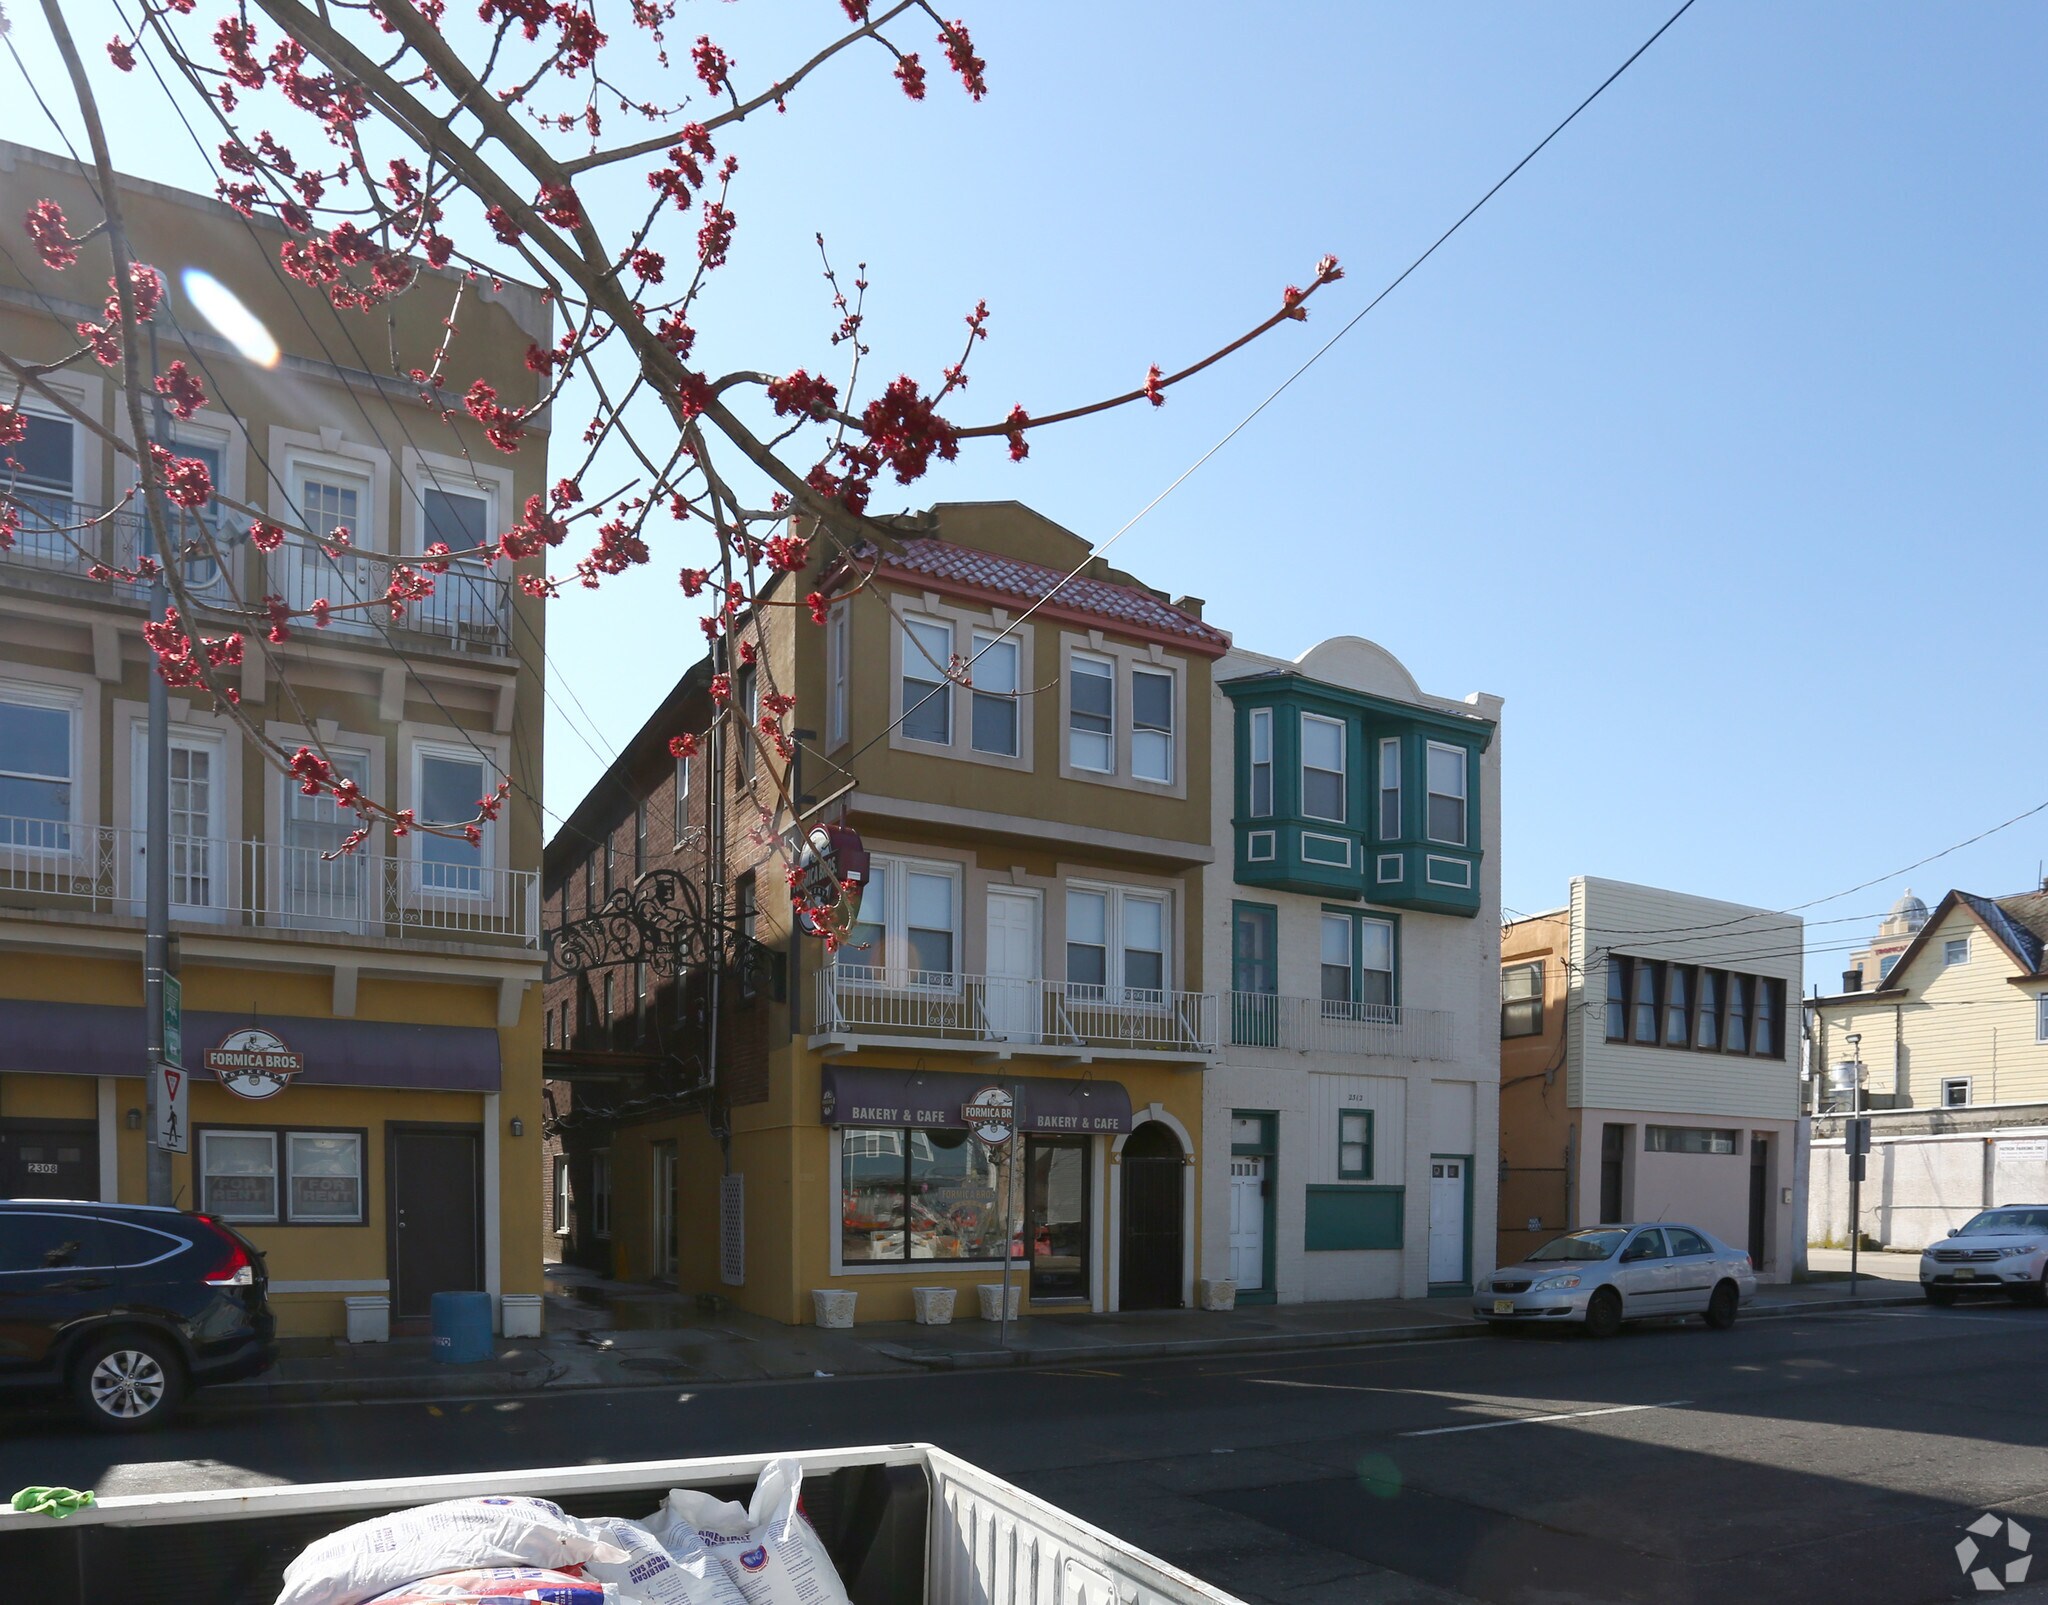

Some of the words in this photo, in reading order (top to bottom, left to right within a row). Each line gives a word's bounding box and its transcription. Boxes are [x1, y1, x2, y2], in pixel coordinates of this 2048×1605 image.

[210, 1052, 263, 1067] FORMICA
[265, 1055, 300, 1069] BROS.
[229, 1069, 280, 1079] BAKERY
[852, 1106, 898, 1120] BAKERY
[903, 1109, 911, 1121] &
[917, 1110, 945, 1122] CAFE
[965, 1107, 1000, 1118] FORMICA
[1001, 1108, 1012, 1118] BR
[1037, 1115, 1077, 1128] BAKERY
[1082, 1117, 1089, 1128] &
[1094, 1118, 1119, 1129] CAFE
[28, 1163, 57, 1173] 2308
[219, 1177, 256, 1188] FOR
[309, 1178, 346, 1190] FOR
[212, 1189, 262, 1201] RENT
[303, 1190, 351, 1201] RENT
[645, 1555, 667, 1568] ROCK
[629, 1564, 647, 1577] SALT
[631, 1560, 671, 1585] AMERICAN
